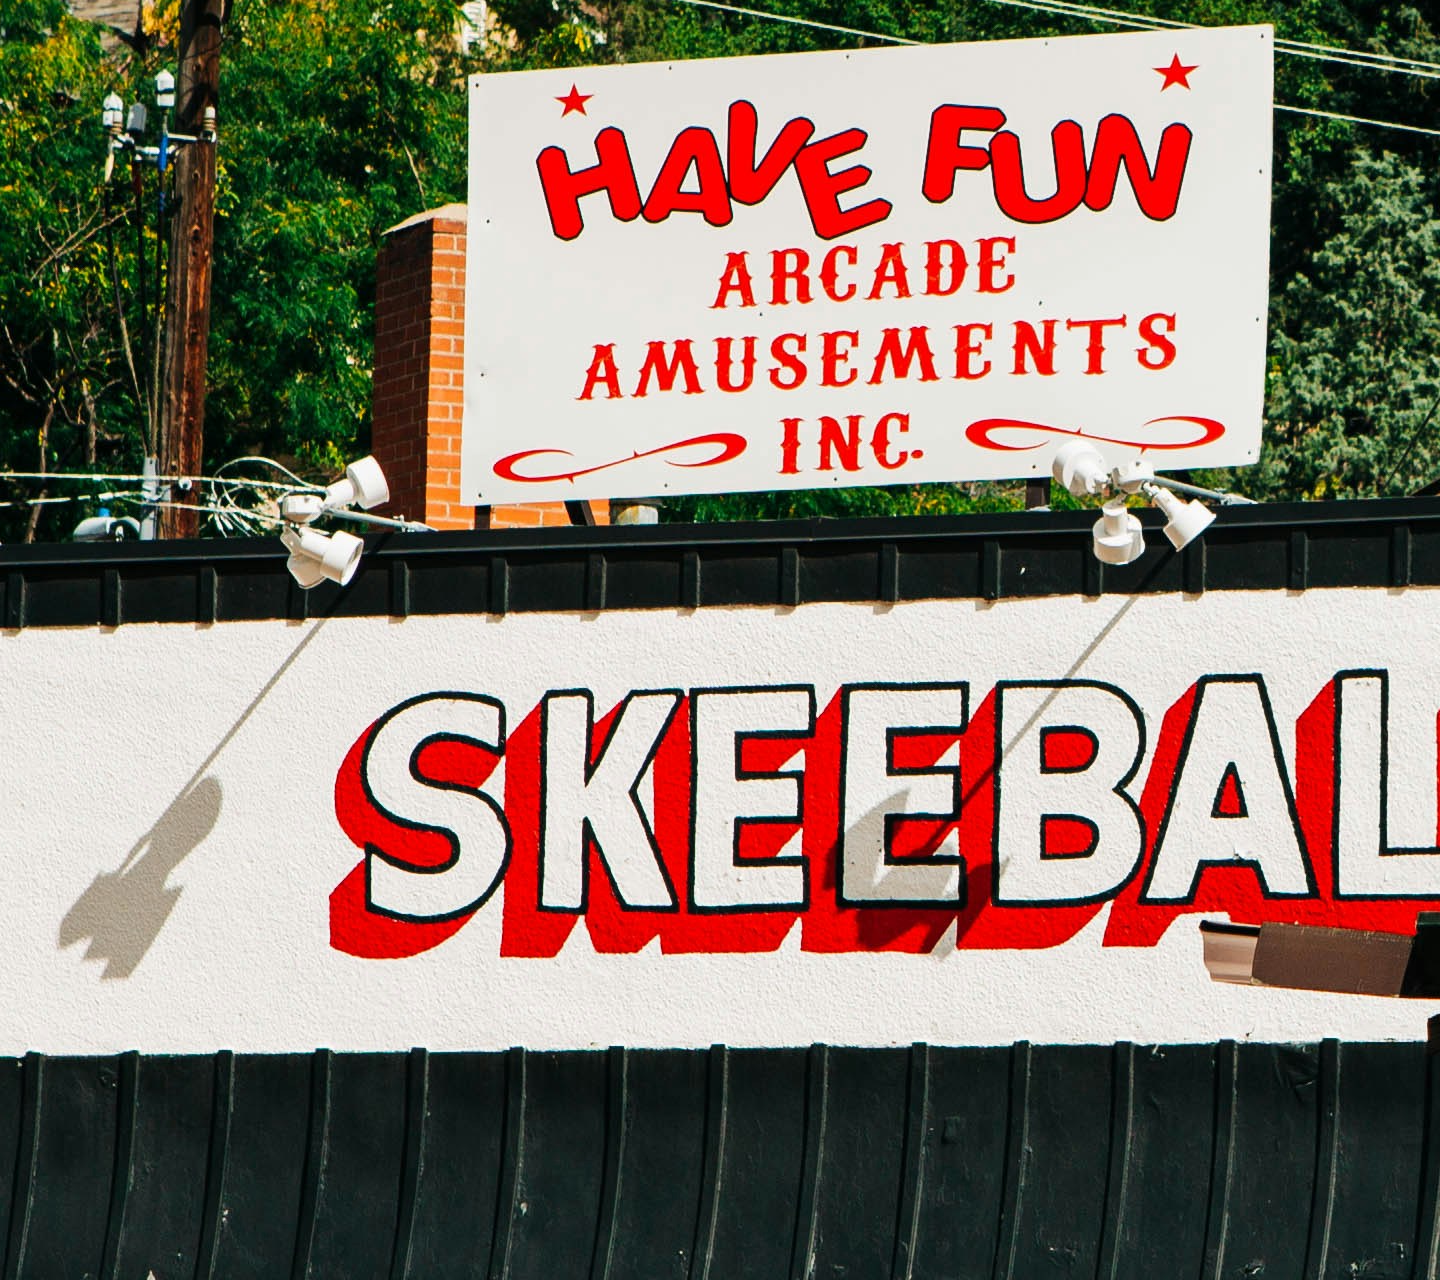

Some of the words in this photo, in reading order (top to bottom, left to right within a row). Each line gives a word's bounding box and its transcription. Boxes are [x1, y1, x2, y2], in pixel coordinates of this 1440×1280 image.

[536, 99, 893, 241] HAVE
[921, 103, 1193, 224] FUN
[709, 235, 1017, 310] ARCADE
[575, 313, 1178, 402] AMUSEMENTS
[779, 412, 925, 475] INC.
